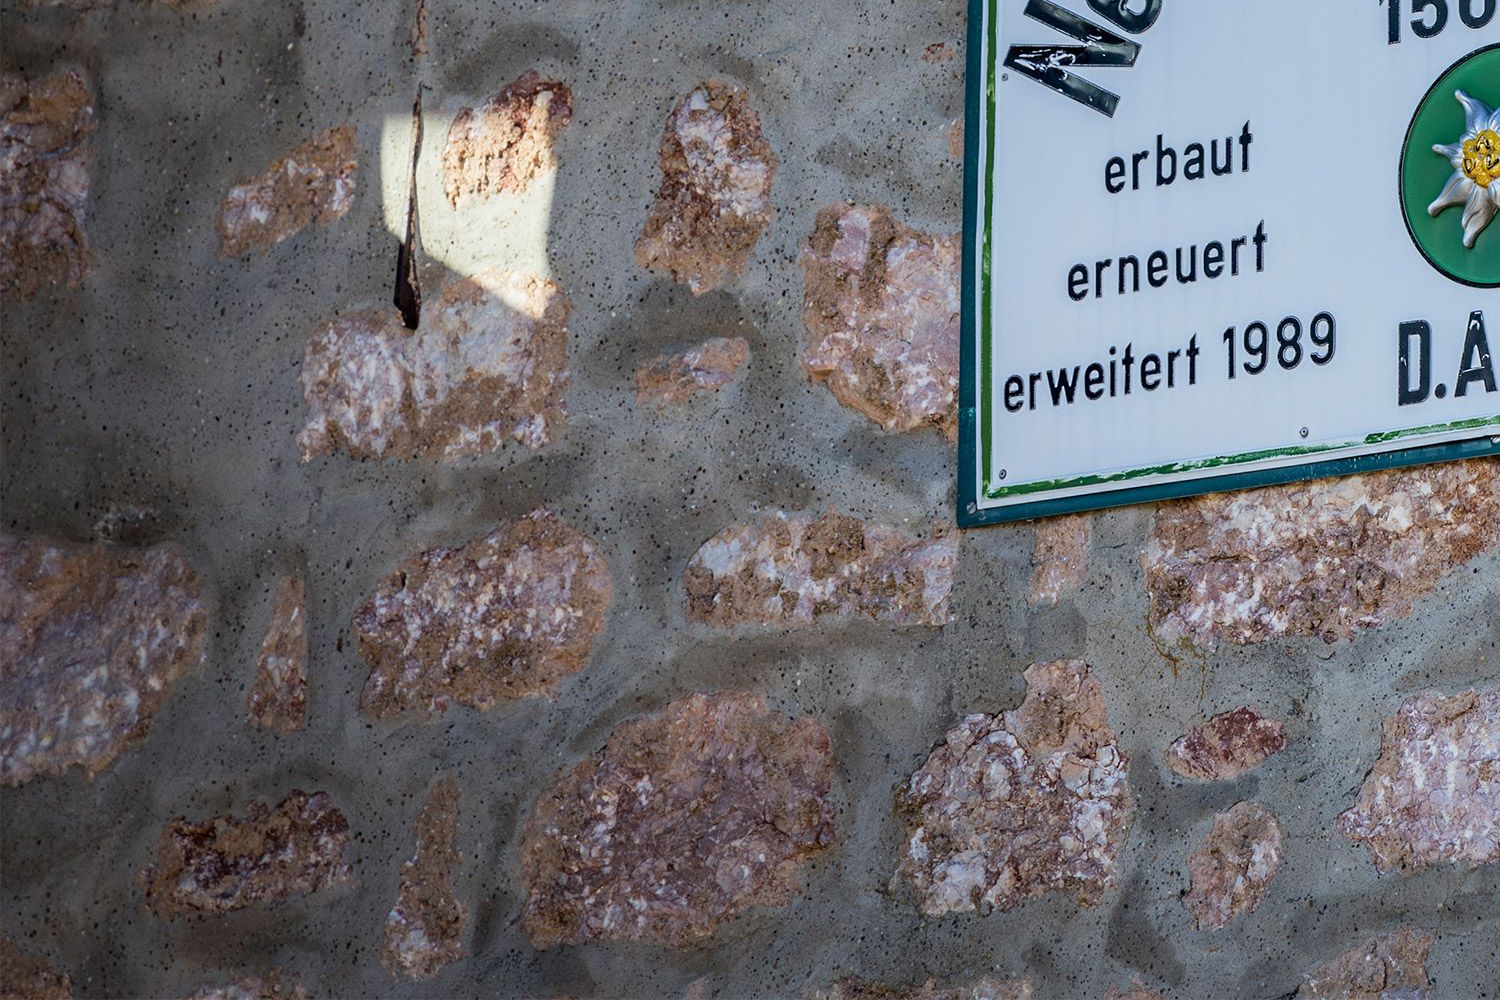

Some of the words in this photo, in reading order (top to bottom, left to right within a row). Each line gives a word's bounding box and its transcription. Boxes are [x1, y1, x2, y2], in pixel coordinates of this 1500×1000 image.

[1104, 120, 1254, 193] erbaut
[1067, 220, 1268, 301] erneuert
[1003, 334, 1201, 413] erweitert
[1222, 311, 1337, 380] 1989
